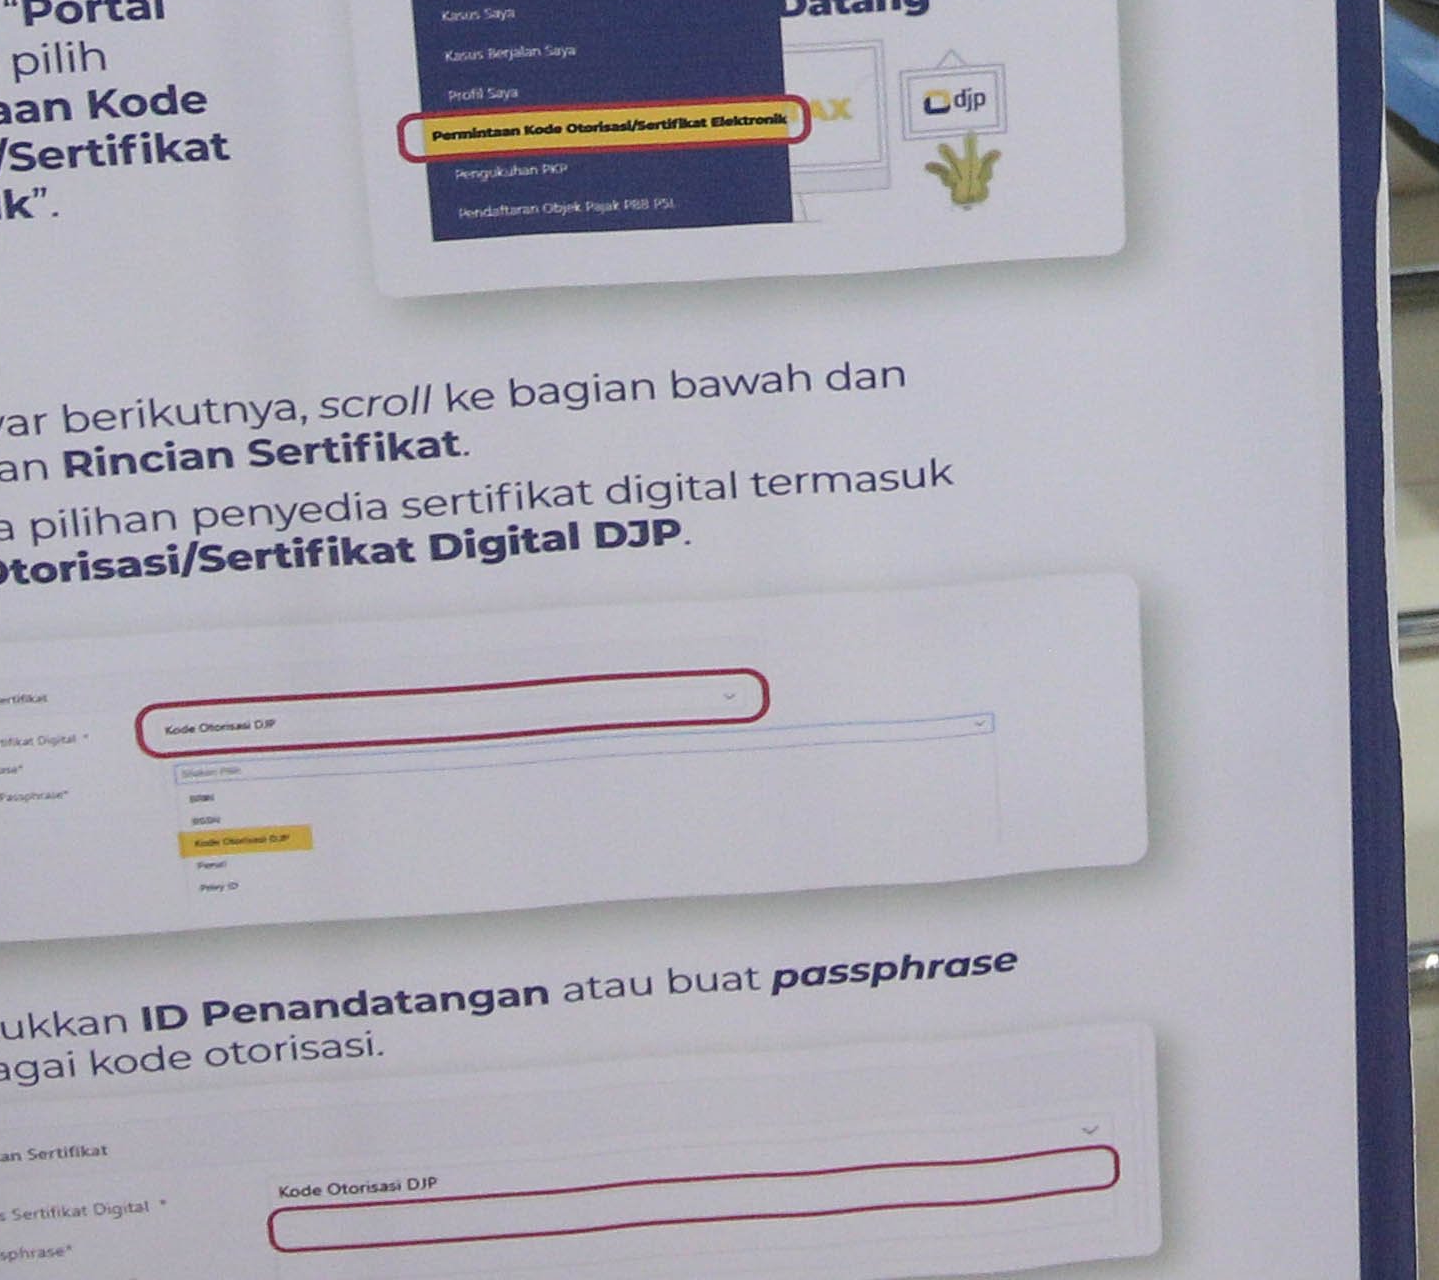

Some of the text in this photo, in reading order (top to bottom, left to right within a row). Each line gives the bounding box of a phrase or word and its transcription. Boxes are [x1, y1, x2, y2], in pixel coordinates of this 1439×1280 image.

[484, 8, 516, 22] Saya
[11, 43, 108, 84] pilih
[488, 46, 541, 61] Berjalan
[545, 45, 577, 59] Saya
[87, 85, 208, 121] Kode
[448, 87, 519, 102] Profil Saya
[954, 87, 986, 111] djp
[432, 113, 787, 142] Permintaan Kode Otorisasi/Sertifikat Elektronik
[455, 166, 538, 182] Pengukuhan
[543, 201, 581, 216] Objek
[584, 199, 621, 215] Pajak
[63, 394, 308, 436] berikutnya,
[319, 384, 431, 420] scroll
[444, 382, 495, 413] ke
[509, 374, 655, 416] bagian
[670, 362, 812, 400] bawah
[826, 360, 905, 392] dan
[63, 441, 234, 480] Rincian
[248, 428, 469, 469] Sertifikat.
[30, 505, 177, 546] pilihan
[192, 492, 389, 532] penyedia
[401, 477, 592, 520] sertifikat
[606, 469, 737, 509] digital
[750, 457, 954, 499] termasuk
[430, 522, 580, 565] Digital
[595, 519, 692, 550] DJP.
[165, 725, 195, 735] Kode
[199, 722, 250, 733] Otorisasi
[37, 734, 77, 747] Digital
[141, 1004, 188, 1033] ID
[203, 989, 549, 1026] Penandatangan
[563, 974, 653, 1004] atau
[668, 966, 761, 995] buat
[771, 947, 1019, 996] passphrase
[90, 1042, 191, 1077] kode
[205, 1029, 385, 1068] otorisasi.
[27, 1144, 108, 1162] Sertifikat
[279, 1176, 438, 1199] Kode Otorisasi DJP
[12, 1205, 87, 1222] Sertifikat
[93, 1200, 149, 1220] Digital
